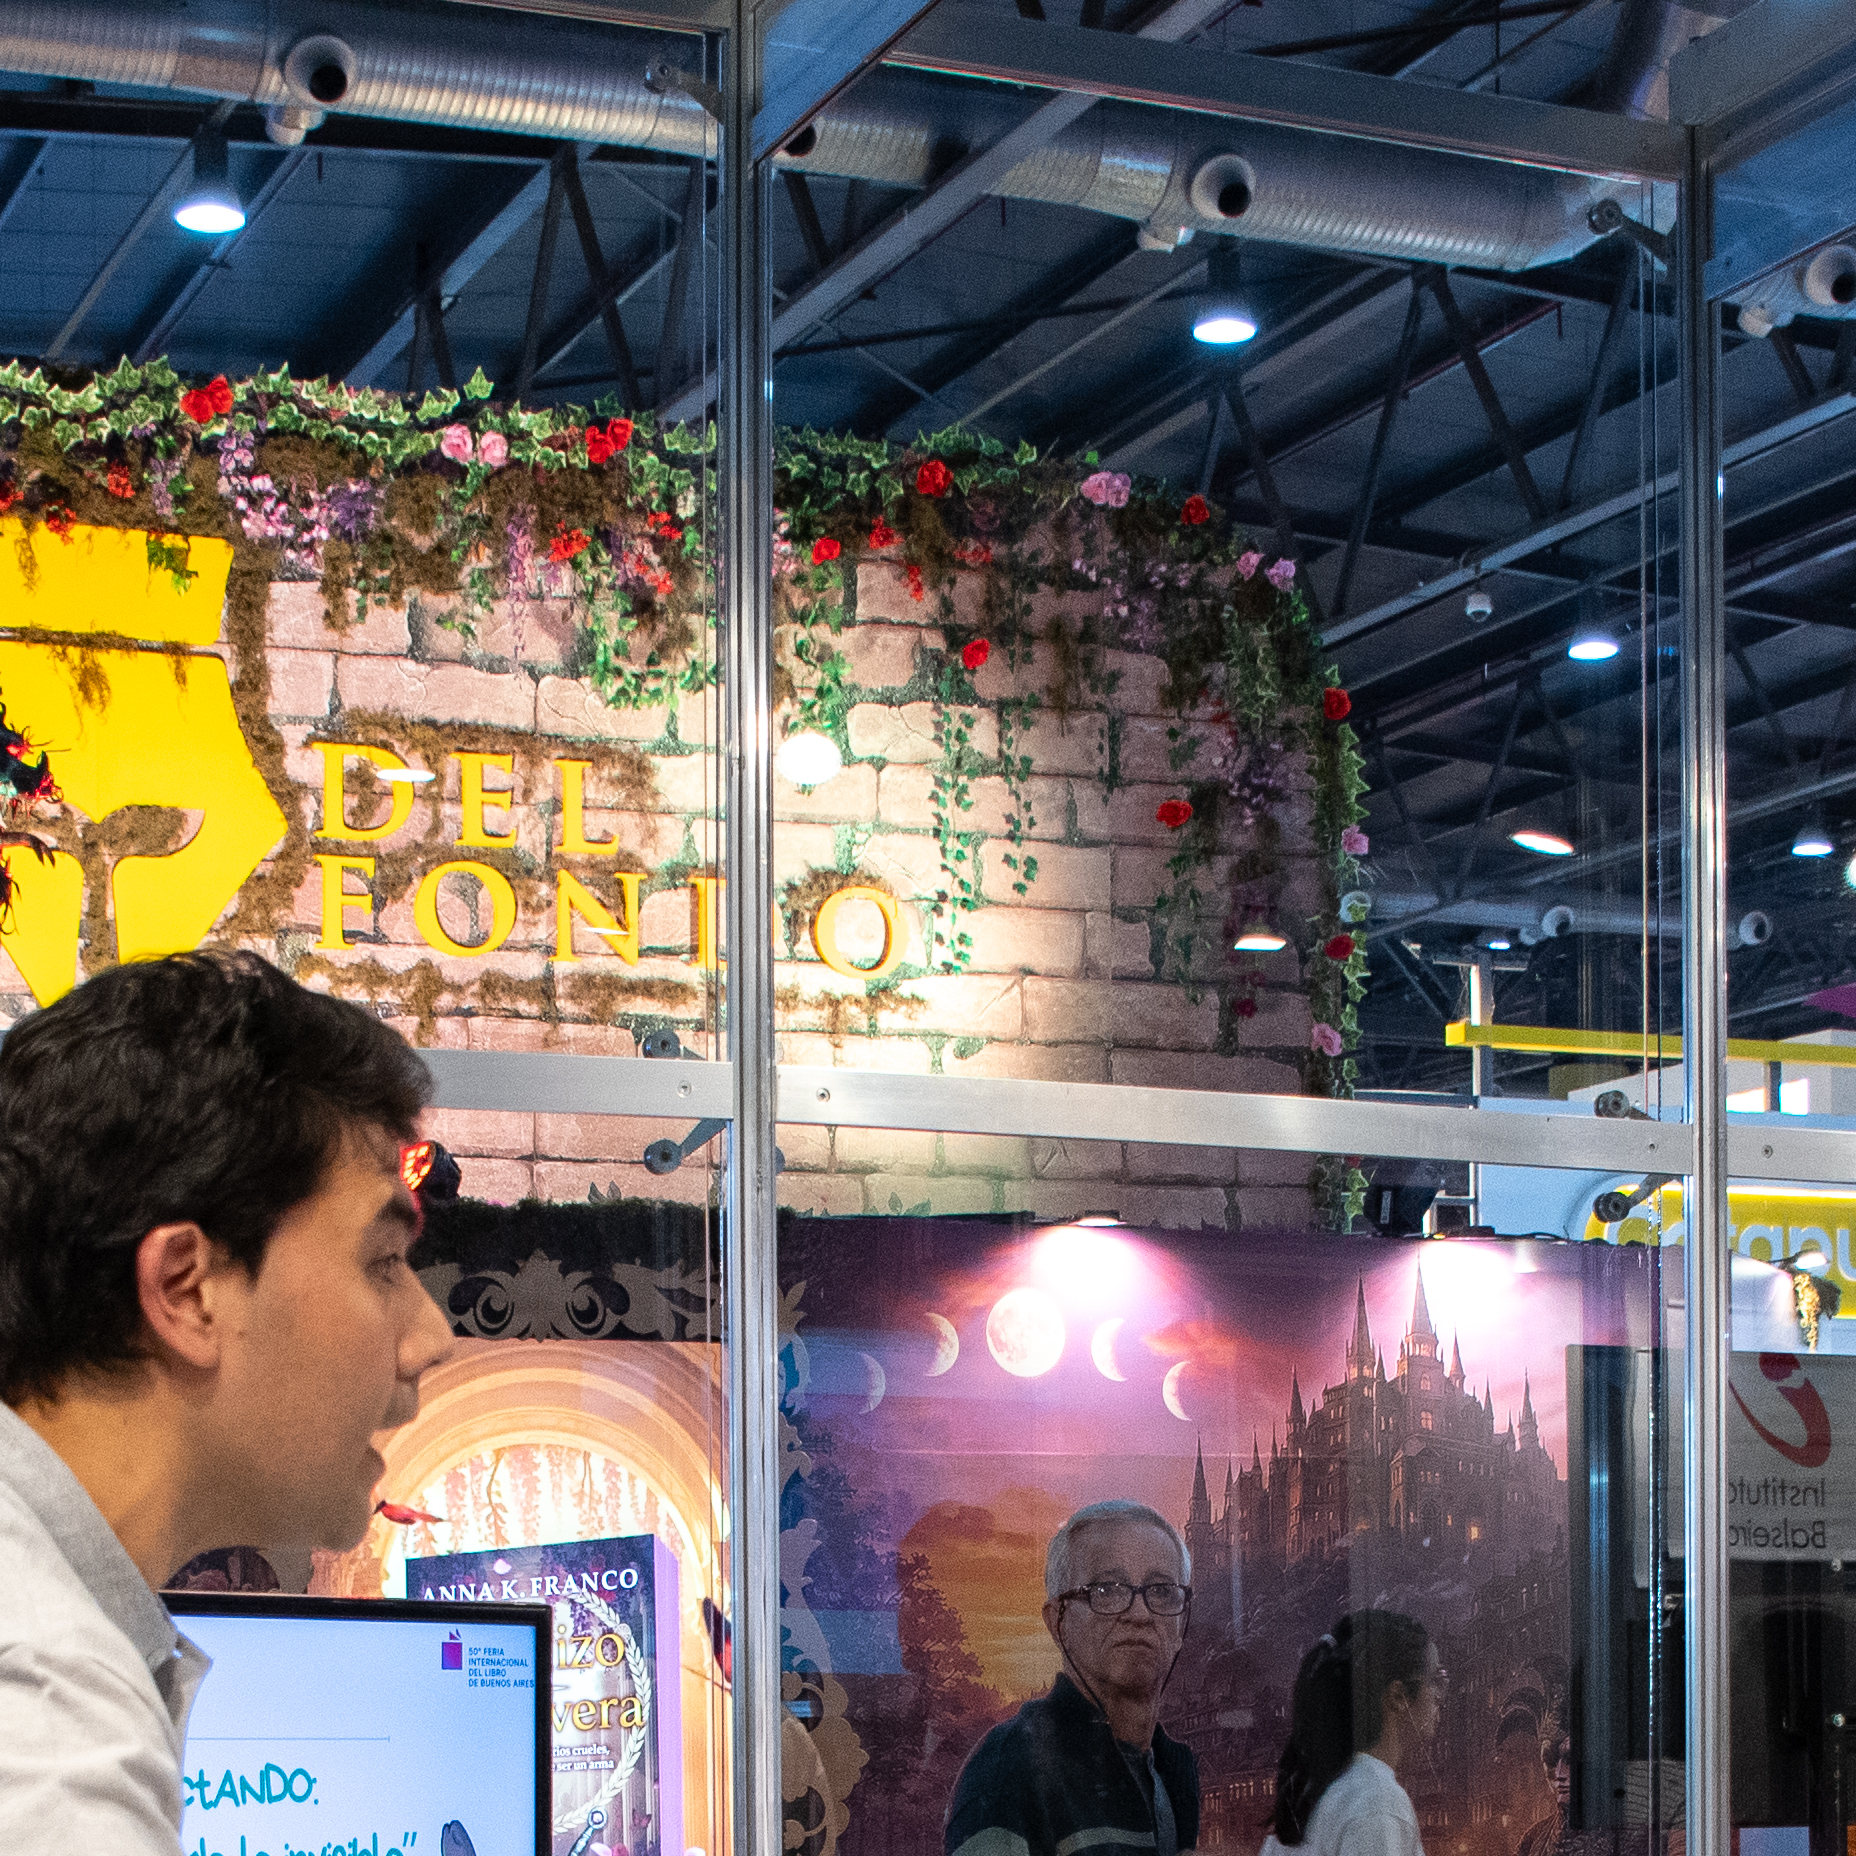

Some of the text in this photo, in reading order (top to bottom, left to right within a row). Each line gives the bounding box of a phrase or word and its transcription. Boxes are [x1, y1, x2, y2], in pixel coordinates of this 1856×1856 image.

[310, 741, 619, 855] DEL
[422, 1568, 639, 1601] ANNA K. FRANCO
[483, 1647, 505, 1656] FERIA
[468, 1657, 529, 1668] INTERNACIONAL
[468, 1668, 507, 1678] DEL LIBRO
[468, 1678, 535, 1689] DE BUENOS AIRES
[572, 1743, 611, 1759] crueles,
[573, 1758, 587, 1771] un
[589, 1757, 615, 1770] arma
